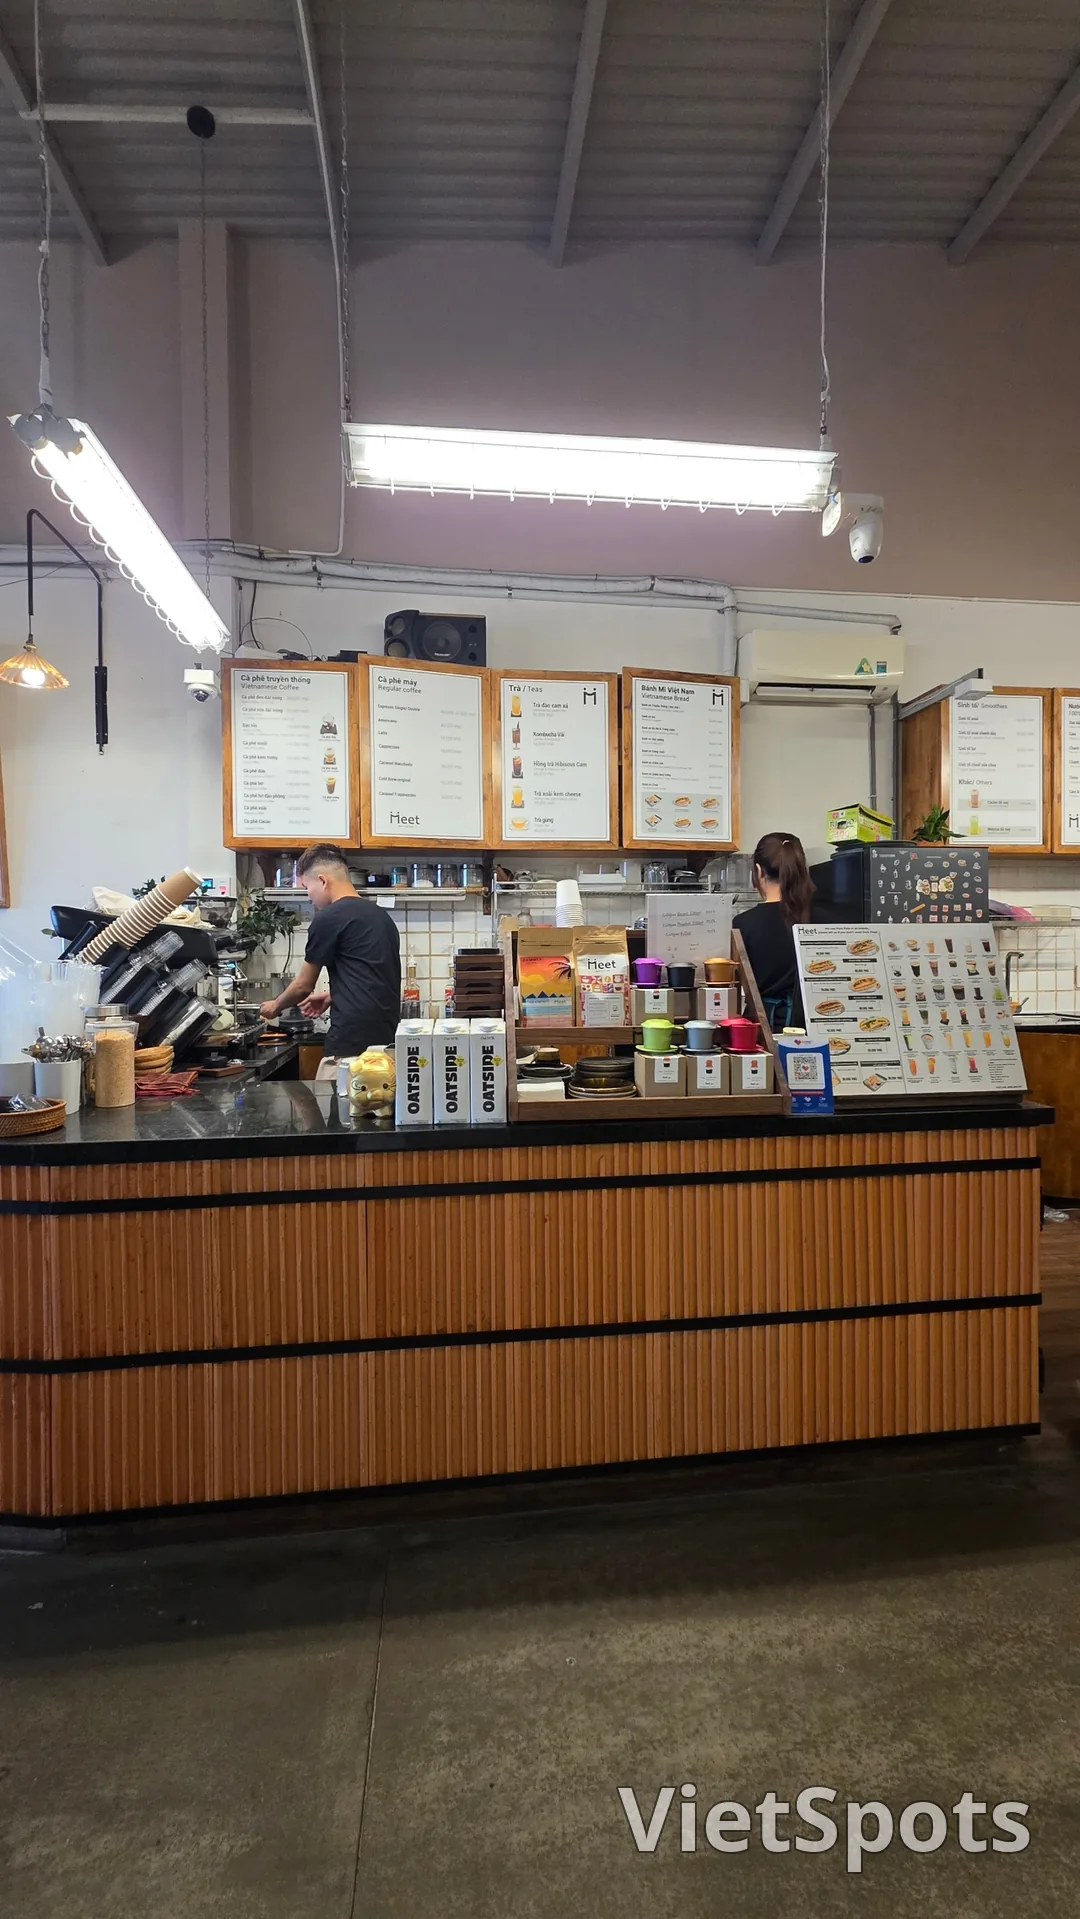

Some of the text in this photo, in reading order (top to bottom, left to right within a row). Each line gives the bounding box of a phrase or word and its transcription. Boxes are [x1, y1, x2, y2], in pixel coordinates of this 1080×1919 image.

[291, 676, 310, 684] thống
[587, 958, 617, 970] Meet
[408, 1046, 420, 1114] OATSIDE
[445, 1046, 458, 1113] OATSIDE
[482, 1045, 495, 1112] OATSIDE
